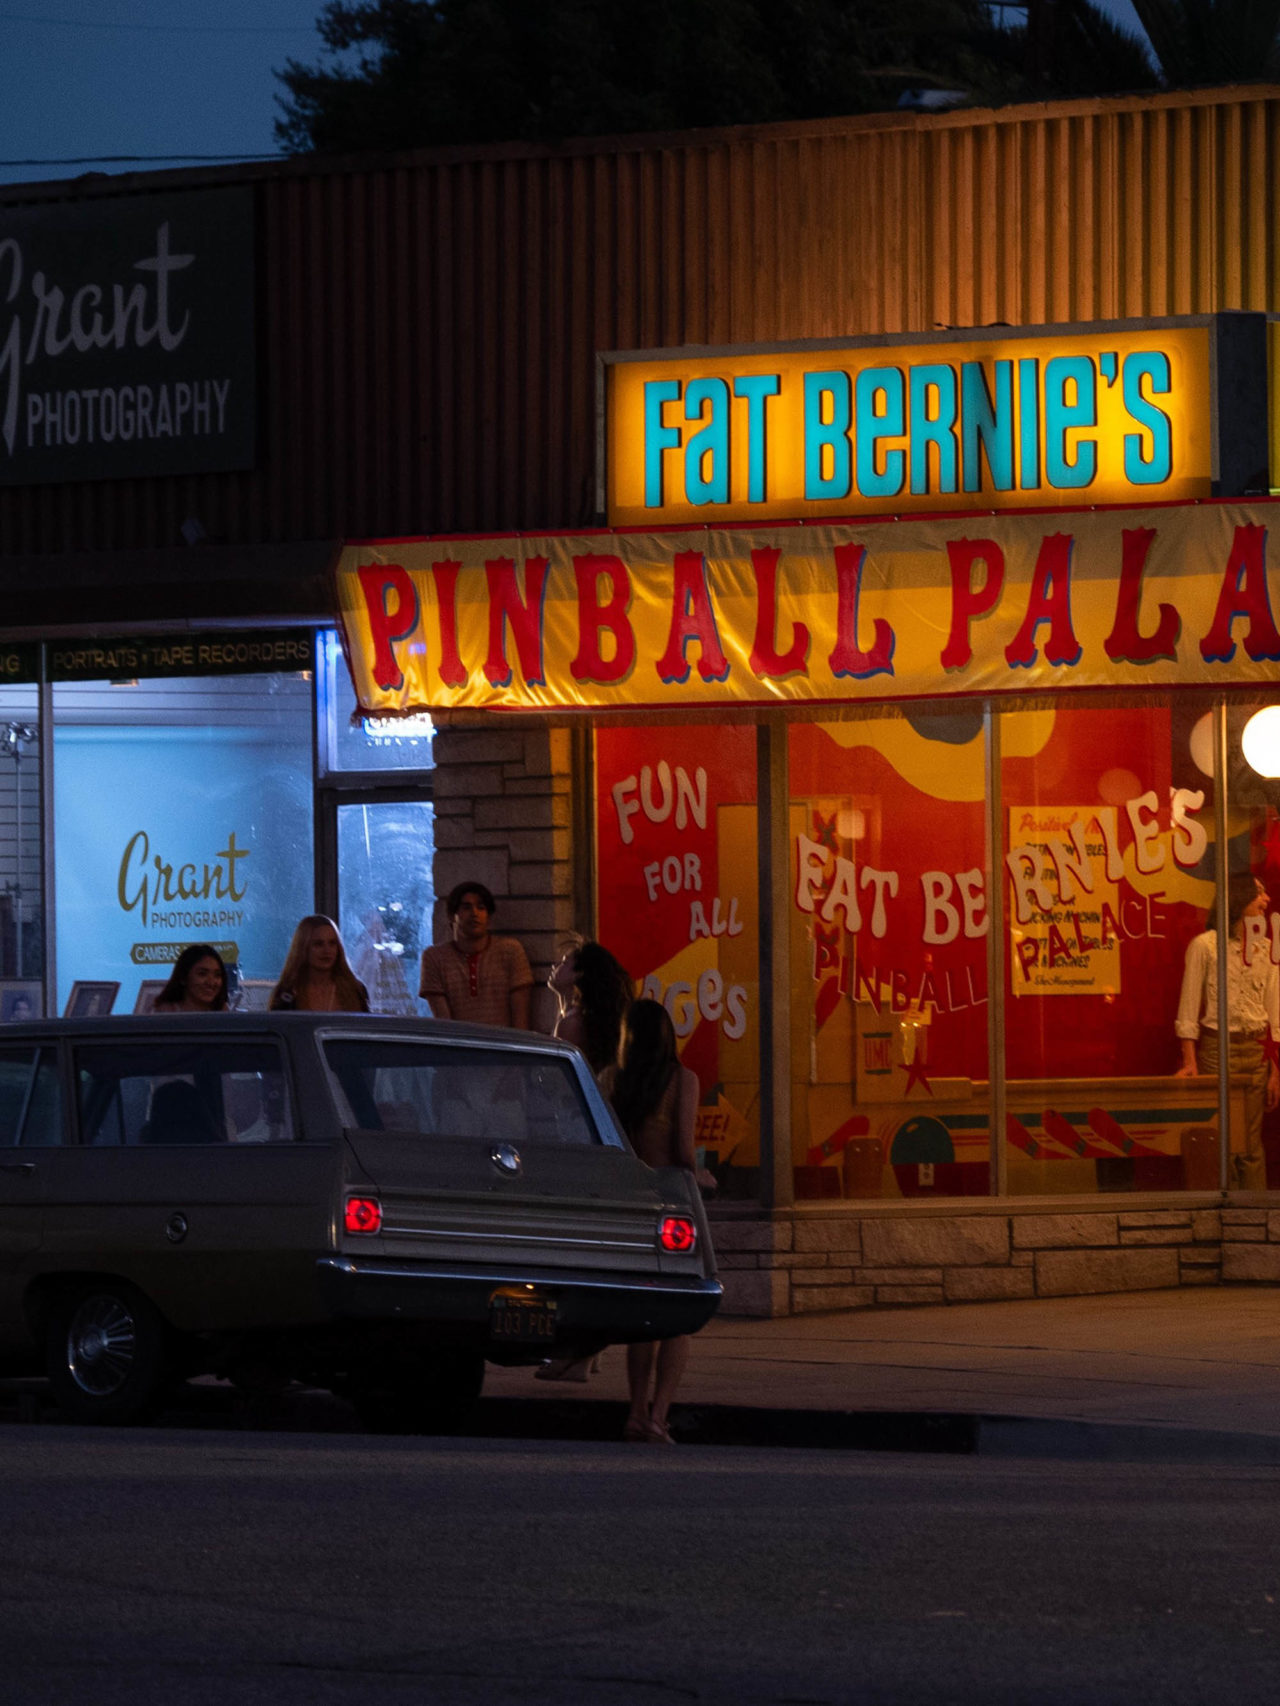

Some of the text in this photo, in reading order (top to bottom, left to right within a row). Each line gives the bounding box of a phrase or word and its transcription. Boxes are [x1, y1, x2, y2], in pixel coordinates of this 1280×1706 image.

[27, 378, 231, 447] PHOTOGRAPHY
[357, 541, 896, 692] PINBALL
[54, 648, 138, 671] PORTRAITS
[151, 645, 194, 667] TAPE
[200, 640, 310, 664] RECORDERS
[611, 760, 708, 845] FUN
[117, 830, 250, 928] Grant
[644, 853, 702, 901] FOR
[795, 833, 899, 941] FAT
[151, 911, 244, 928] PHOTOGRAPHY
[689, 897, 744, 943] ALL
[807, 890, 1167, 1016] PINBALL PALACE
